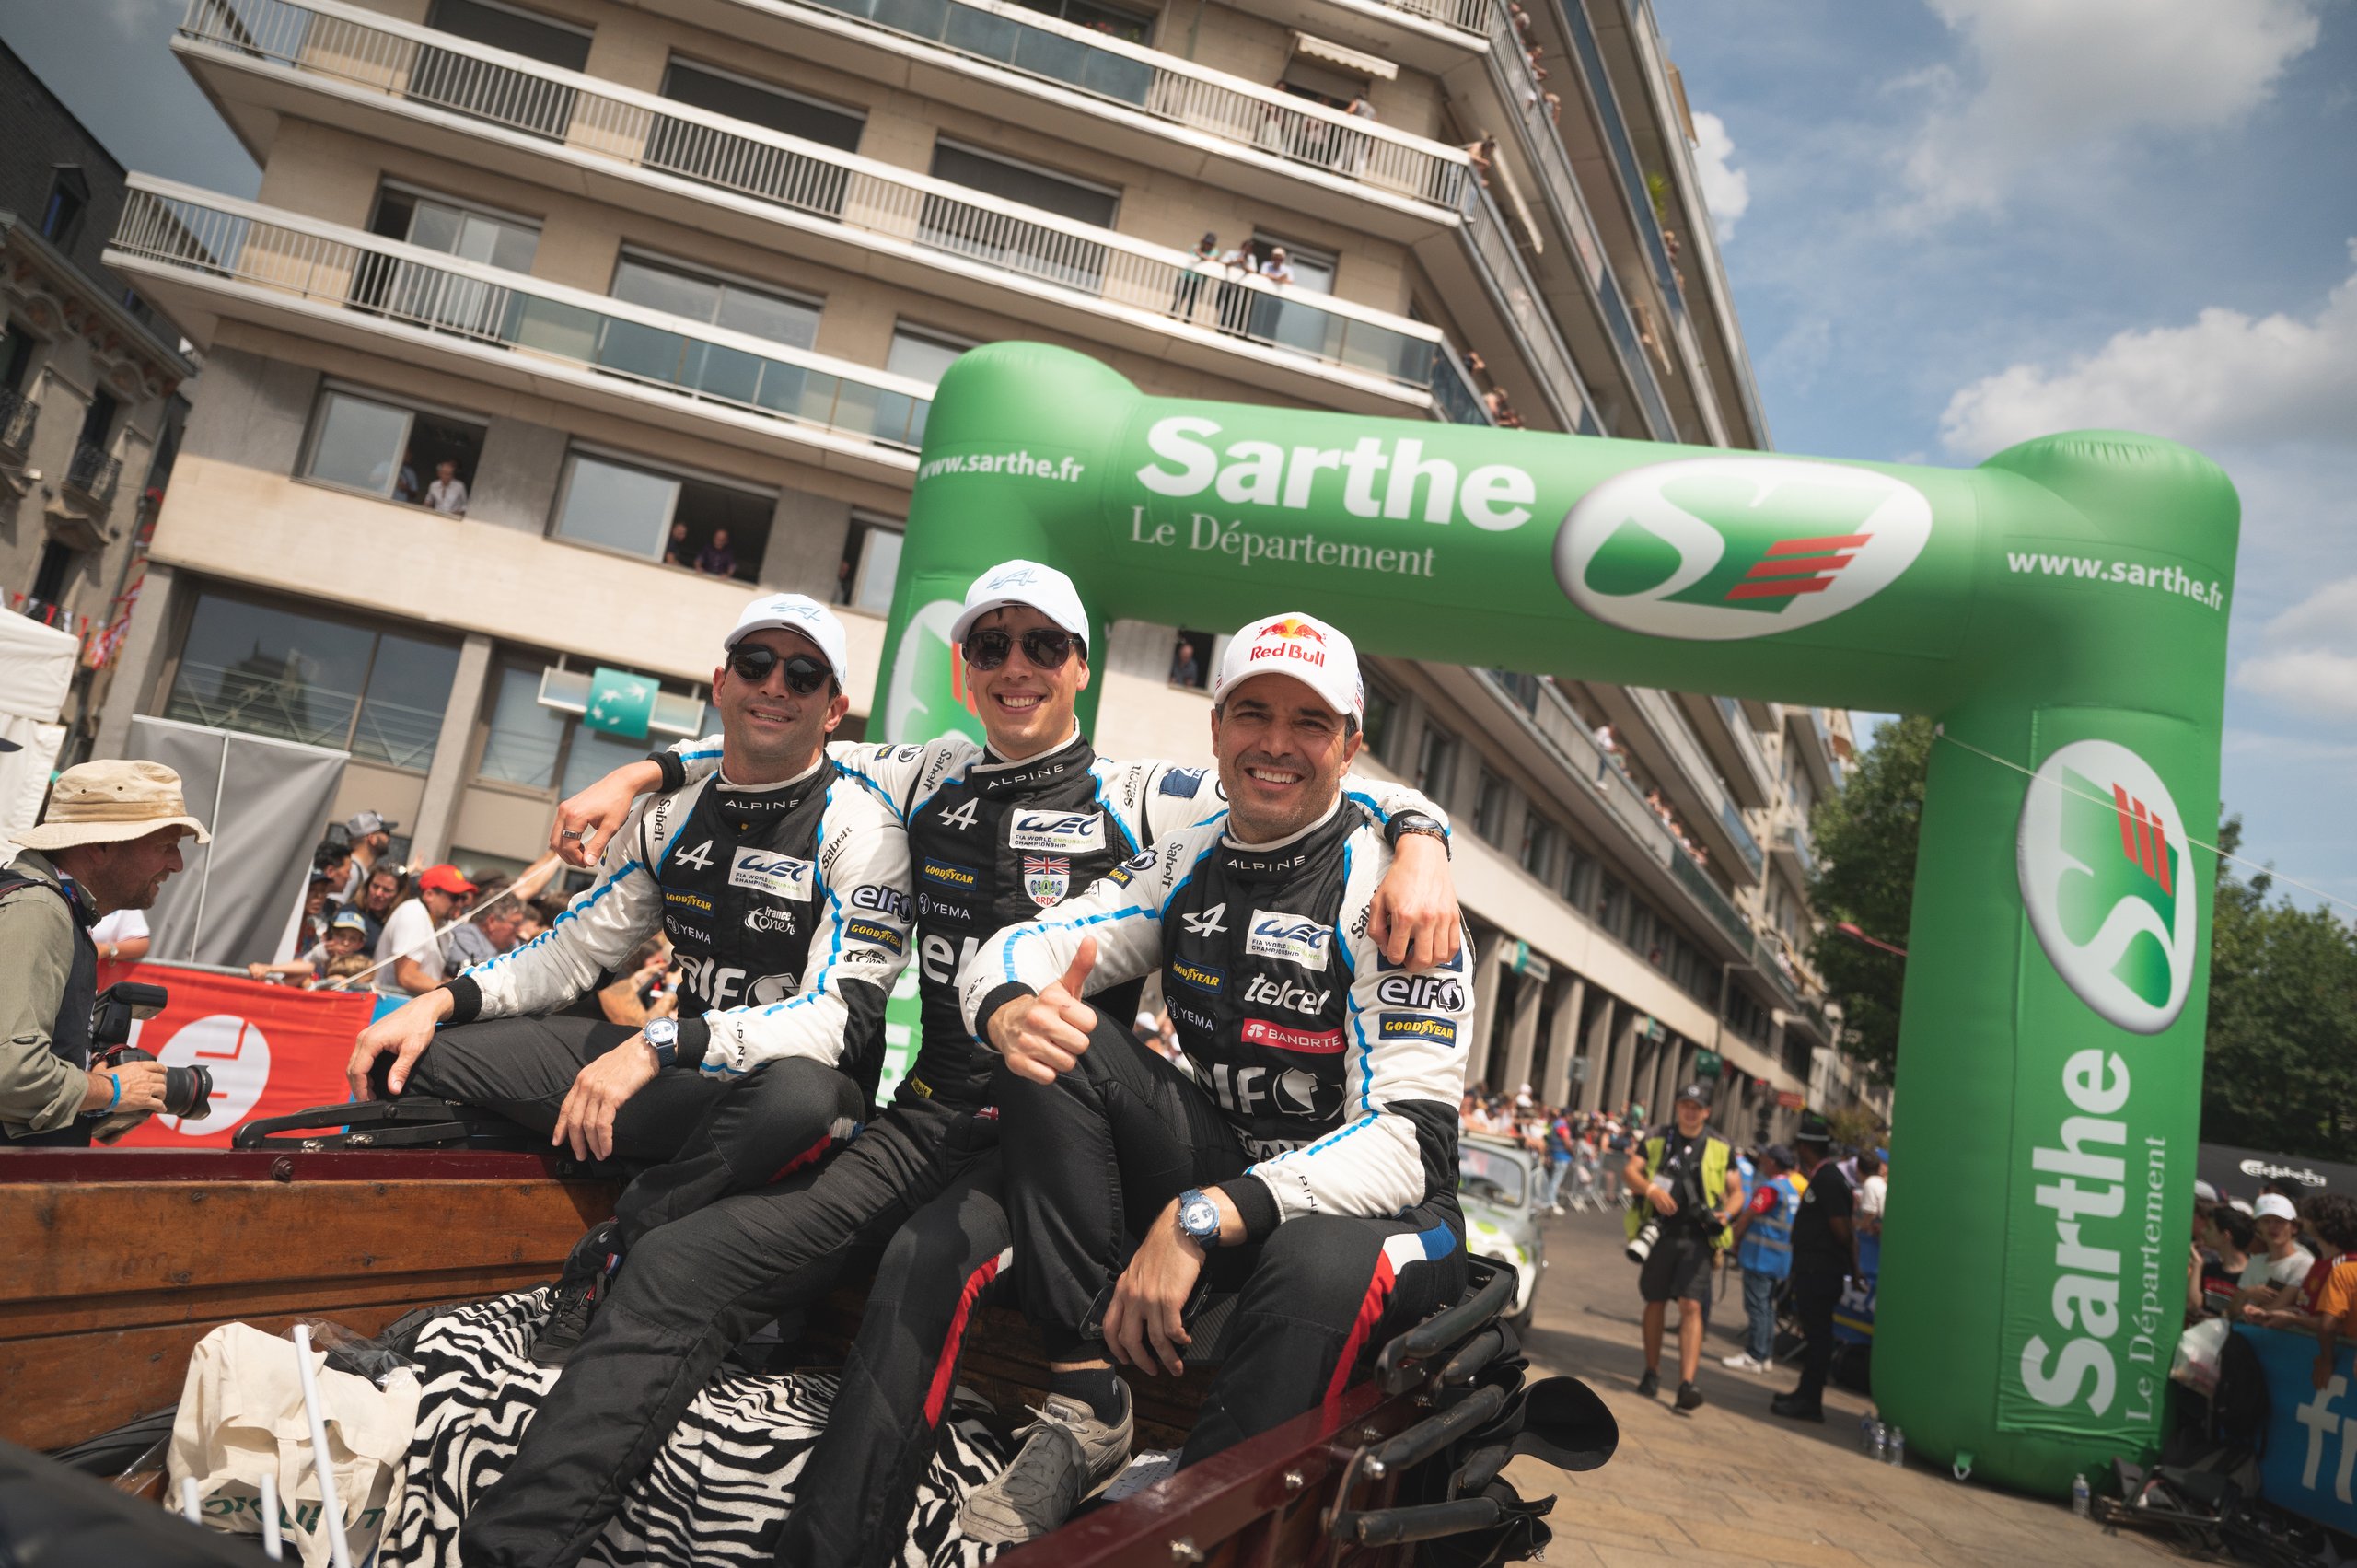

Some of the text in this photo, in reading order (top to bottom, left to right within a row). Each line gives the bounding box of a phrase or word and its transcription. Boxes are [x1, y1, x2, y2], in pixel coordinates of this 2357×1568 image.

[921, 450, 1084, 482] www.sarthe.fr
[1136, 416, 1536, 531] Sarthe
[1130, 506, 1436, 578] Le Département
[2007, 552, 2224, 611] www.sarthe.fr
[1249, 642, 1326, 668] Red Bull
[987, 762, 1065, 791] ALPINE
[725, 799, 800, 811] ALPINE
[655, 798, 671, 842] Sabelt
[1016, 816, 1100, 836] WEC
[821, 826, 853, 870] Sabelt
[1015, 841, 1067, 849] CHAMPIONSHIP
[737, 854, 809, 882] WEC
[924, 864, 974, 885] GOODYEAR
[1162, 842, 1184, 889] Sabelt
[1227, 854, 1306, 873] ALPINE
[666, 892, 713, 912] GOODYEAR
[765, 906, 792, 922] France
[932, 901, 970, 920] YEMA
[1035, 896, 1056, 907] BRDC
[680, 923, 711, 945] YEMA
[1254, 919, 1333, 949] WEC
[1244, 972, 1332, 1016] telcel
[1180, 1007, 1213, 1031] YEMA
[1385, 1019, 1454, 1040] GOODYEAR
[1268, 1028, 1341, 1048] BANORTE
[2019, 1048, 2131, 1418] Sarthe
[2125, 1135, 2167, 1423] Le Département
